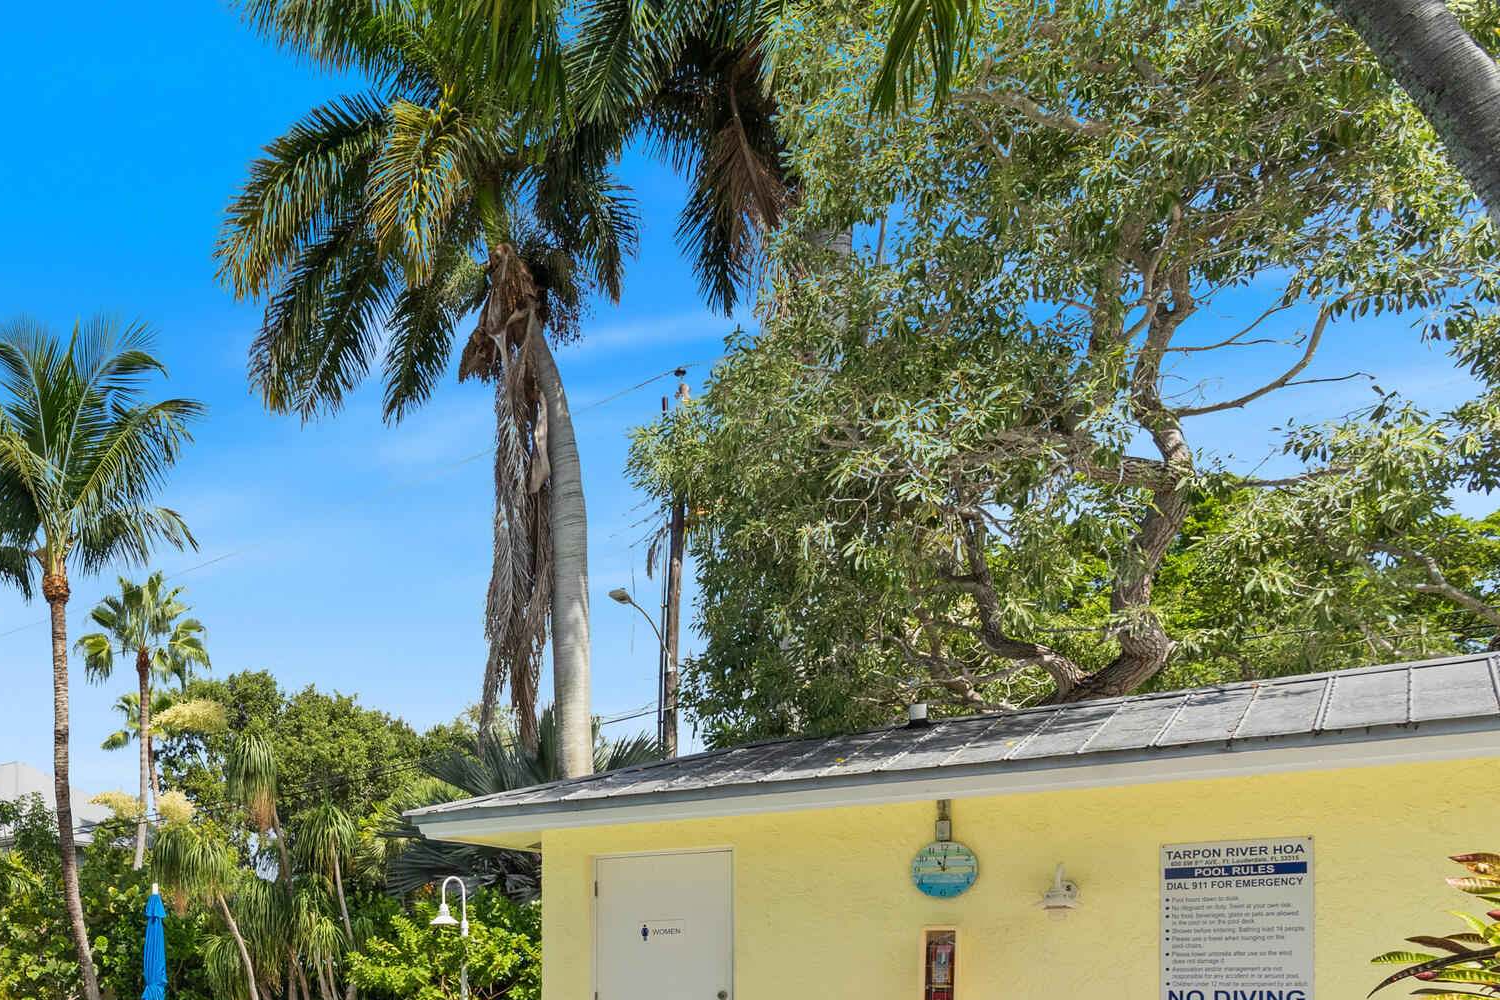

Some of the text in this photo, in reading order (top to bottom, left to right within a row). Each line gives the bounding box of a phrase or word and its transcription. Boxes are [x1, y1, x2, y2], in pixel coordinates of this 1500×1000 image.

[1166, 844, 1305, 860] TARPON RIVER HOA
[1194, 865, 1275, 877] POOL RULES
[1167, 877, 1304, 891] DIAL 911 FOR EMERGENCY
[652, 927, 681, 935] WOMEN
